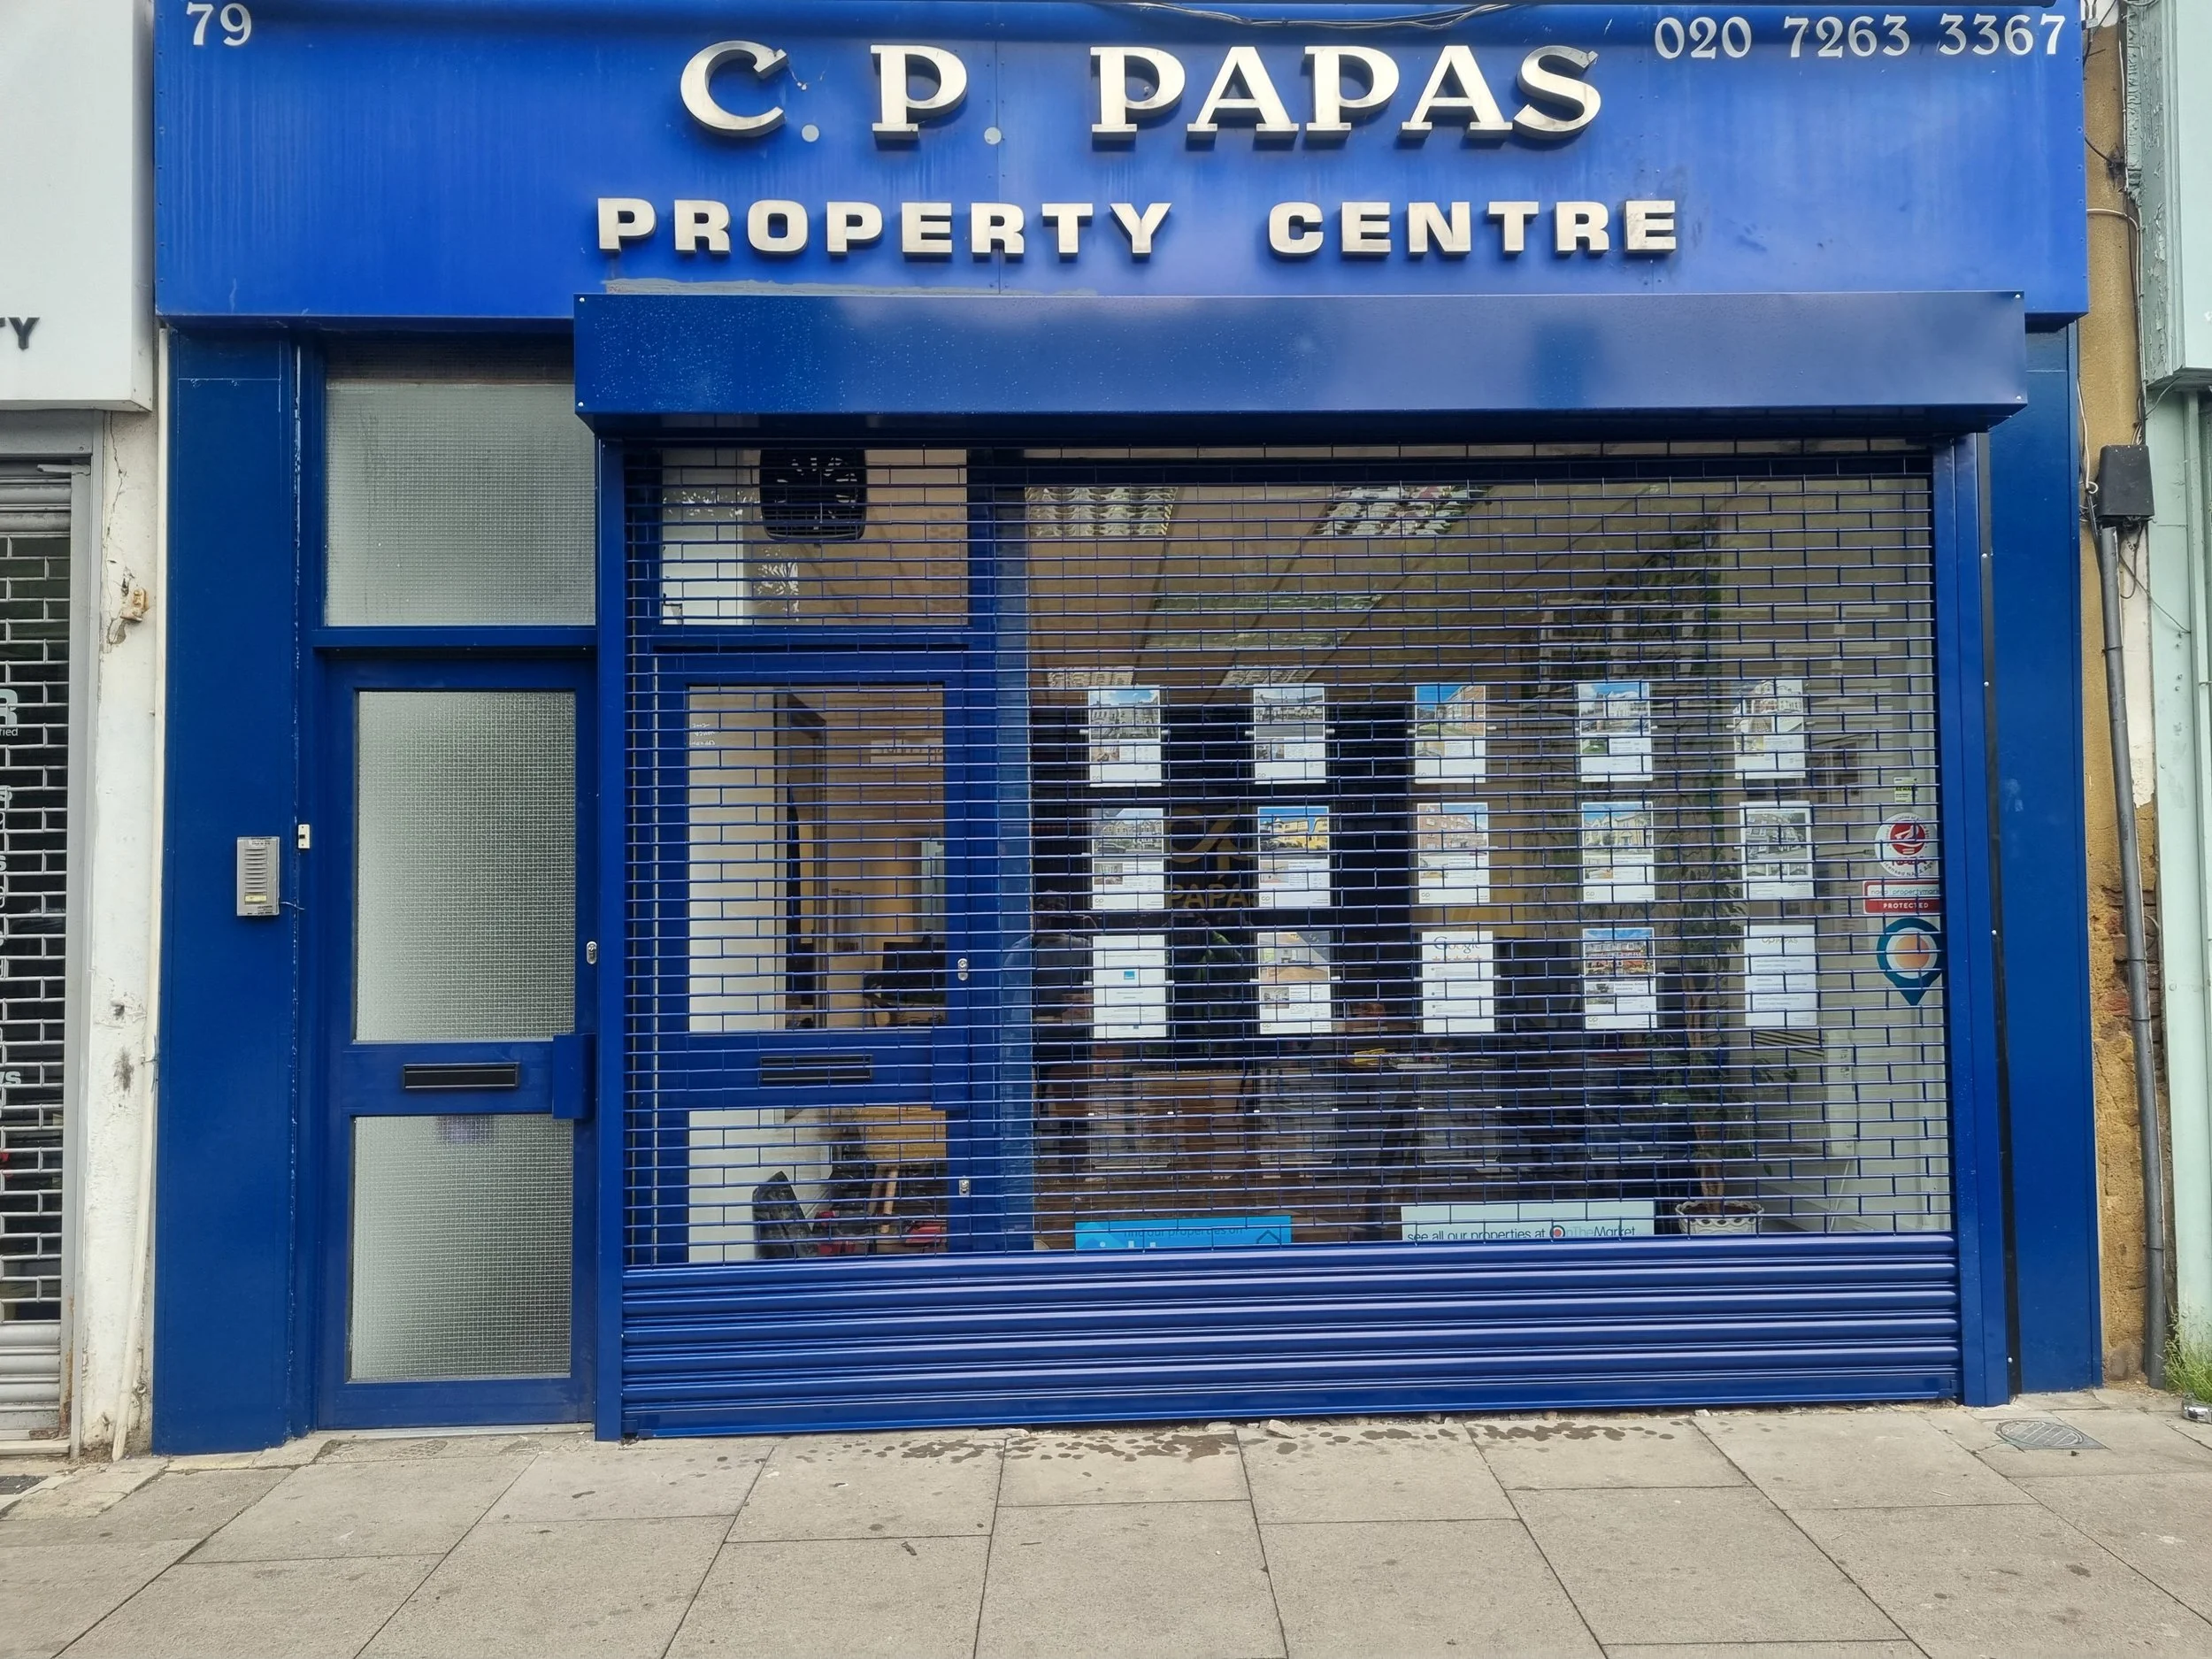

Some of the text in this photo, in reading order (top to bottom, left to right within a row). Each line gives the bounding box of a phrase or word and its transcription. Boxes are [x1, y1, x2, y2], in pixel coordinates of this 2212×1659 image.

[186, 2, 252, 46] 79
[1654, 12, 2066, 59] 020 7263 3367
[1089, 44, 1601, 142] PAPAS
[597, 197, 1677, 258] PROPERTY CENTRE
[1432, 1230, 1444, 1240] all
[1471, 1228, 1531, 1240] properties
[1534, 1228, 1546, 1238] at
